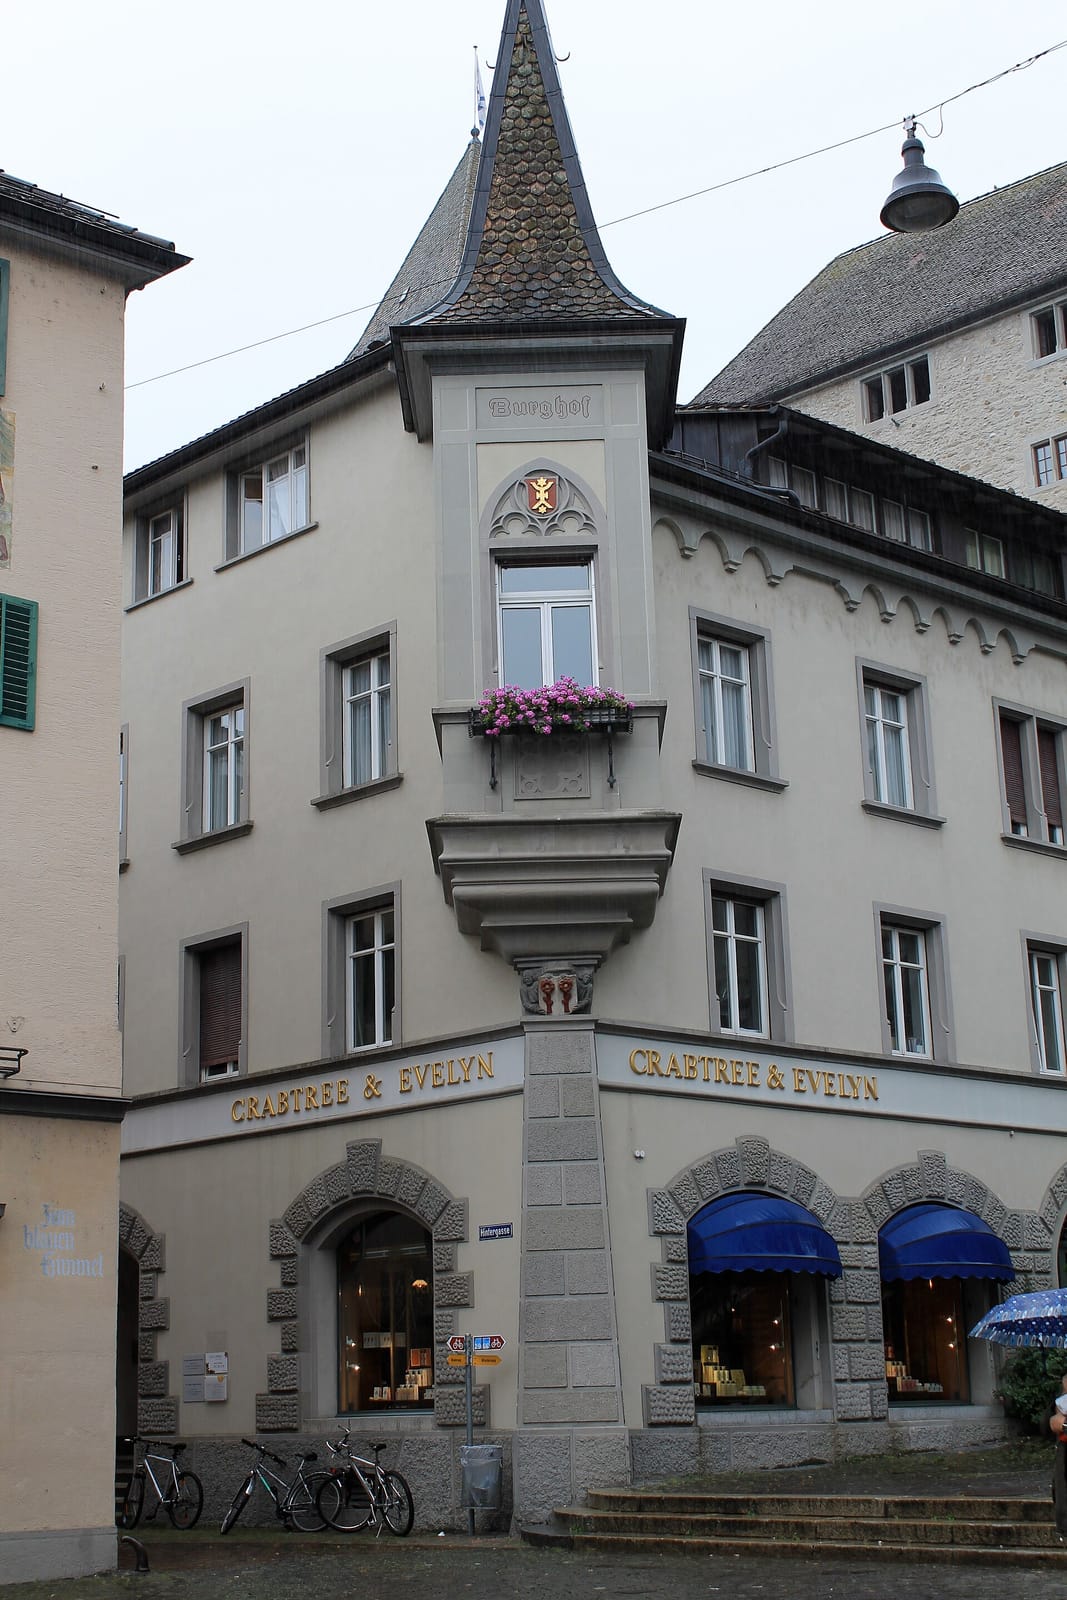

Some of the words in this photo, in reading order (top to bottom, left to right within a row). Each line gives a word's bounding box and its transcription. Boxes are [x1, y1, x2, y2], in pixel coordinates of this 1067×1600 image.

[488, 395, 591, 420] Burghof
[231, 1079, 350, 1122] CRABTREE
[363, 1072, 382, 1100] &
[399, 1051, 495, 1094] EVELYN
[629, 1048, 761, 1087] CRABTREE
[766, 1064, 785, 1090] &
[792, 1067, 880, 1101] EVELYN
[23, 1224, 75, 1249] blauen
[480, 1227, 510, 1238] Hintergasse
[40, 1251, 104, 1279] Himmel
